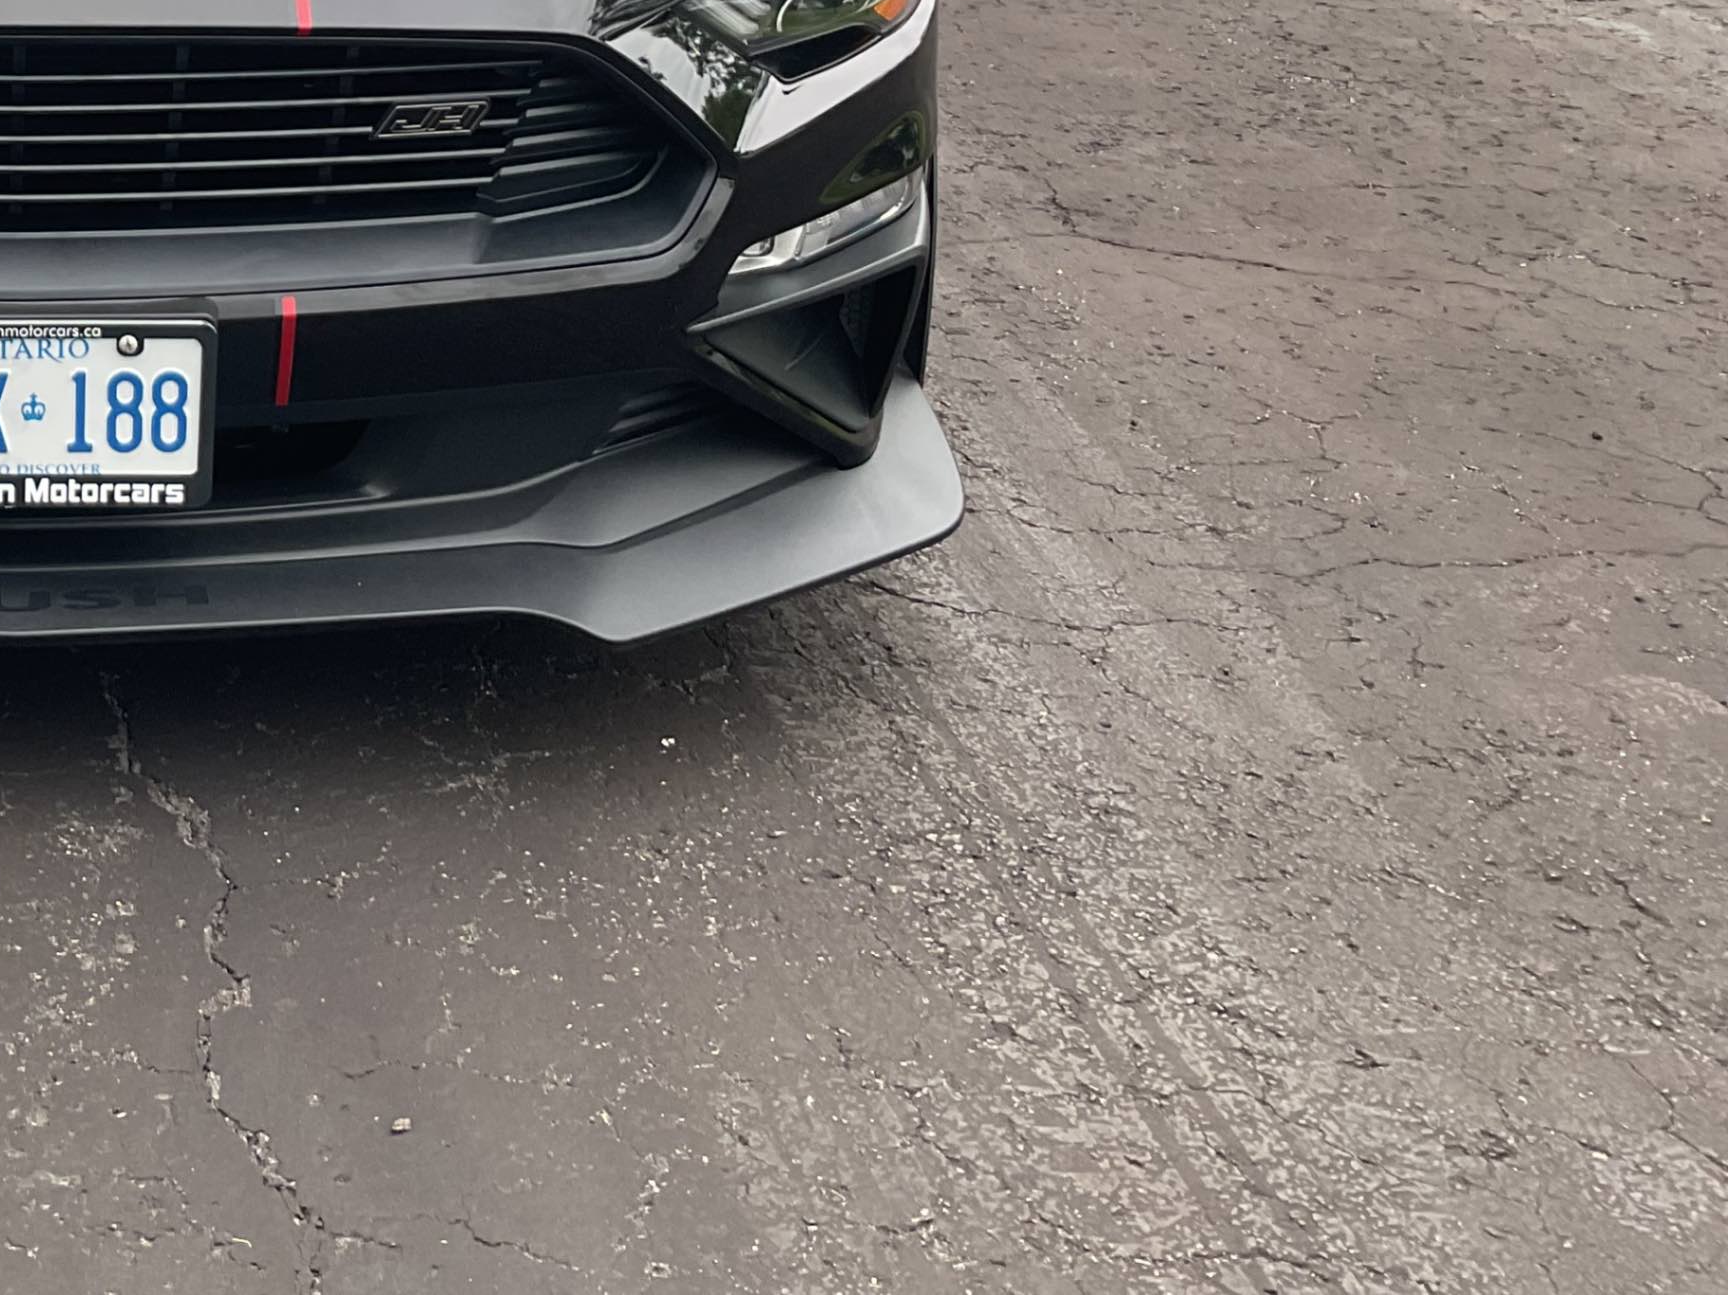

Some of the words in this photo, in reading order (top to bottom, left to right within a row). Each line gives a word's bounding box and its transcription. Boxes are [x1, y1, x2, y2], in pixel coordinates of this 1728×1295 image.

[67, 370, 188, 454] 188
[16, 462, 102, 476] DISCOVER
[24, 477, 185, 505] Motorcars
